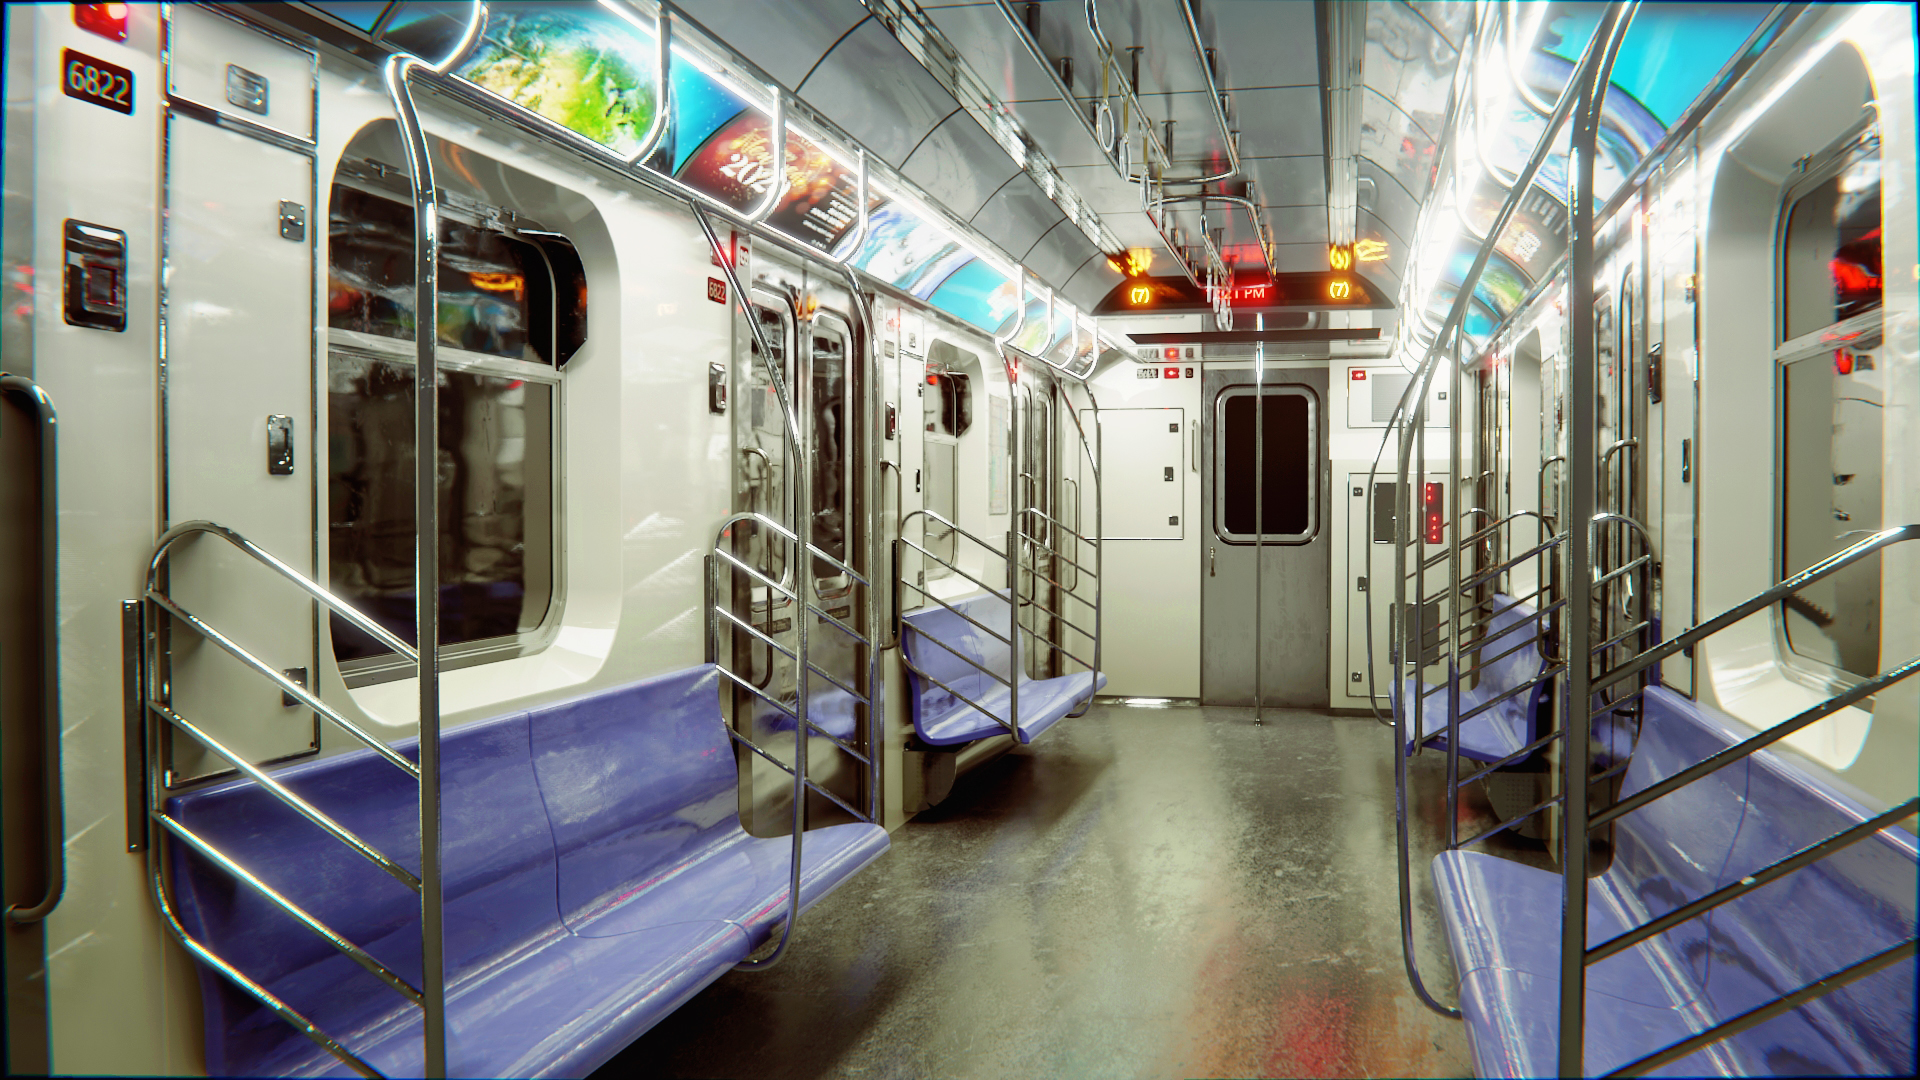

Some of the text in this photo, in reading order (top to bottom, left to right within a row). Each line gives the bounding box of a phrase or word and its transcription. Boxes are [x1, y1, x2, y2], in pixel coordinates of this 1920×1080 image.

[67, 60, 130, 106] 6822
[709, 281, 726, 300] 6822
[1244, 287, 1265, 299] PM
